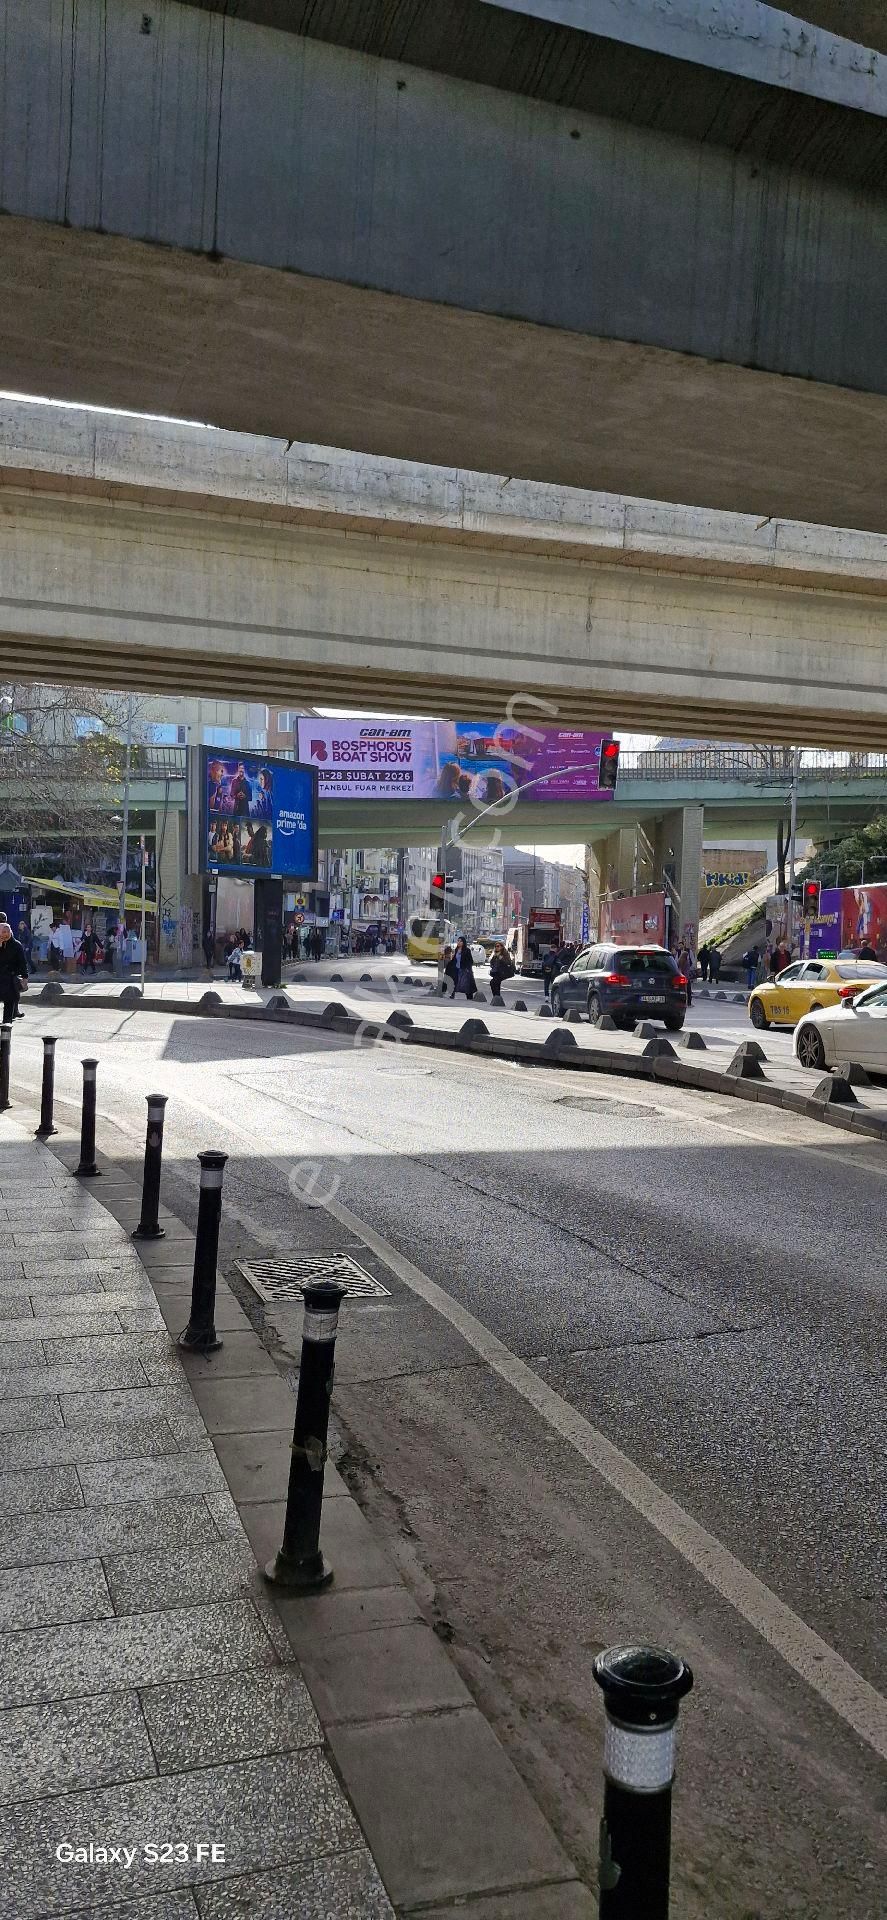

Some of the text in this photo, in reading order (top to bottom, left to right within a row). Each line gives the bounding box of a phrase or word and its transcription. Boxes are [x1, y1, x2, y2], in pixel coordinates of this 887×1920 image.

[332, 740, 412, 752] BOSPHORUS
[332, 752, 412, 763] BOAT SHOW
[346, 772, 382, 781] ŞUBAT
[385, 773, 411, 781] 2026
[279, 809, 305, 820] amazon
[276, 820, 297, 831] prime
